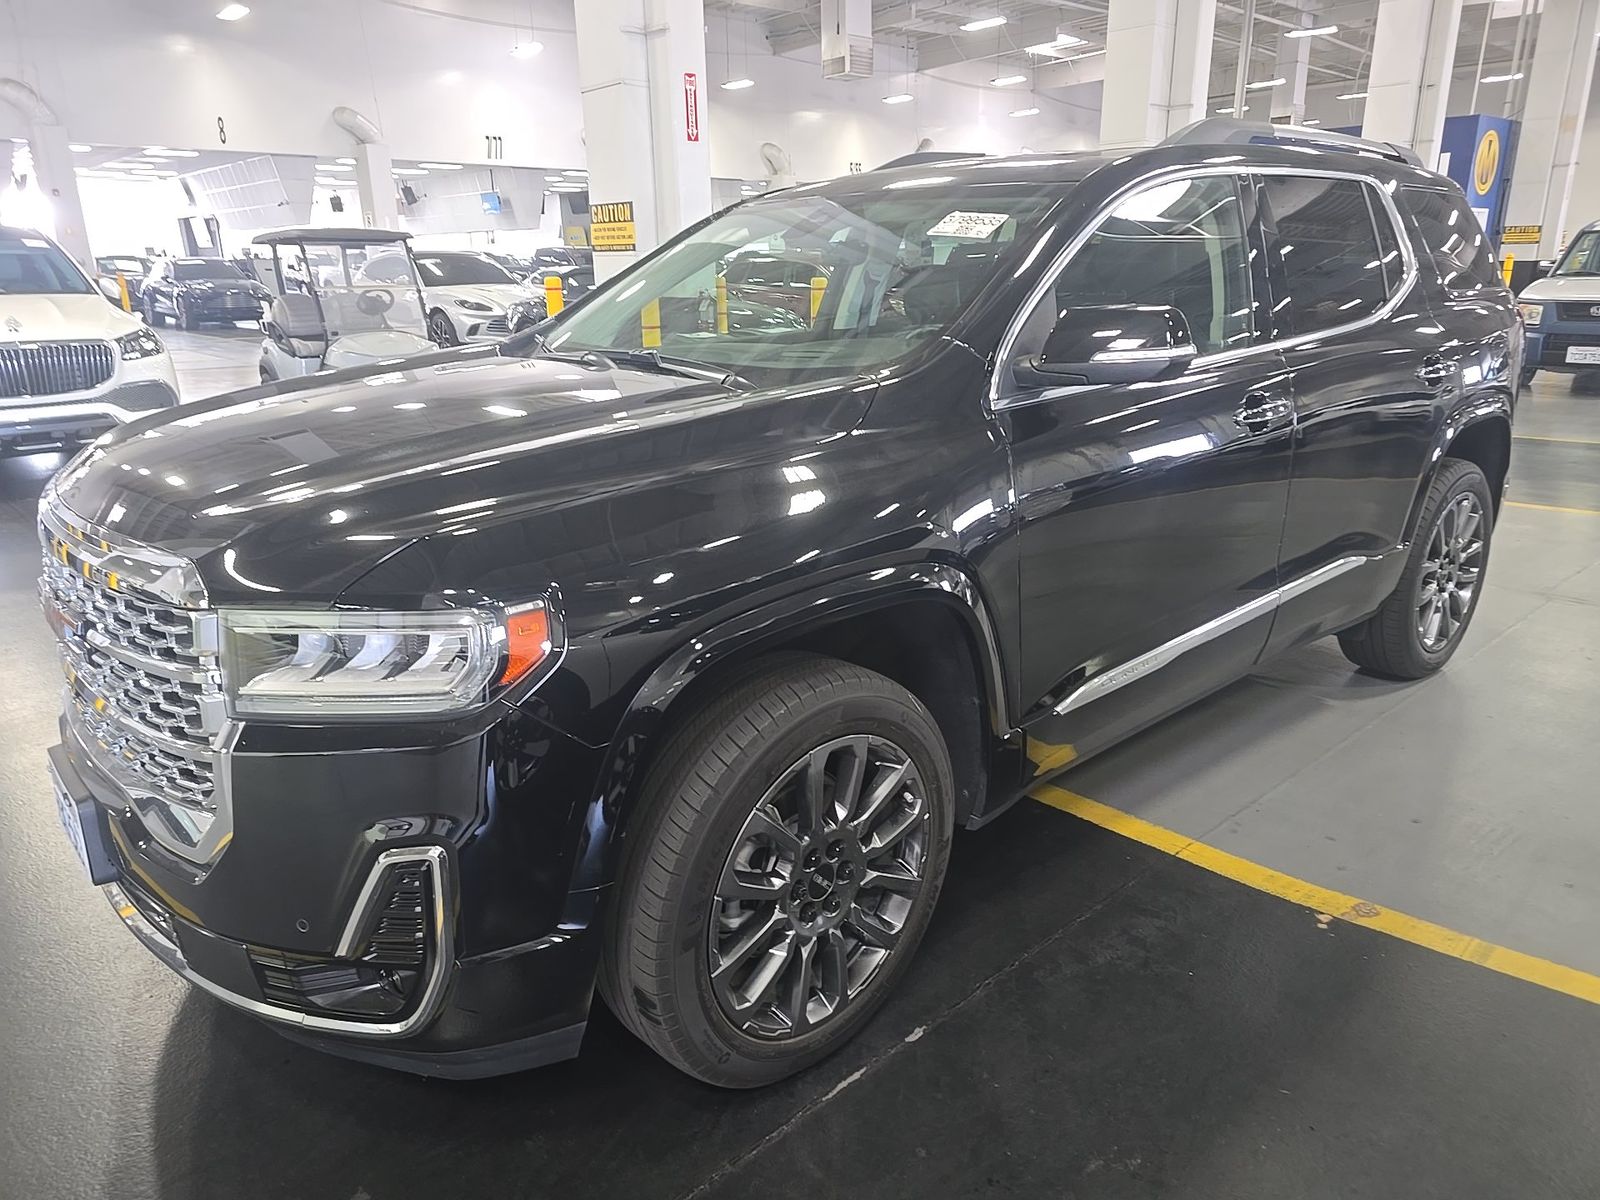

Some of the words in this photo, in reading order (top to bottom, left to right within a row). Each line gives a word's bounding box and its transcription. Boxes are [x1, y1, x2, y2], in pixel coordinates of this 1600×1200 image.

[217, 116, 227, 145] 8
[591, 203, 631, 223] CAUTION
[1505, 226, 1540, 234] CAUTION
